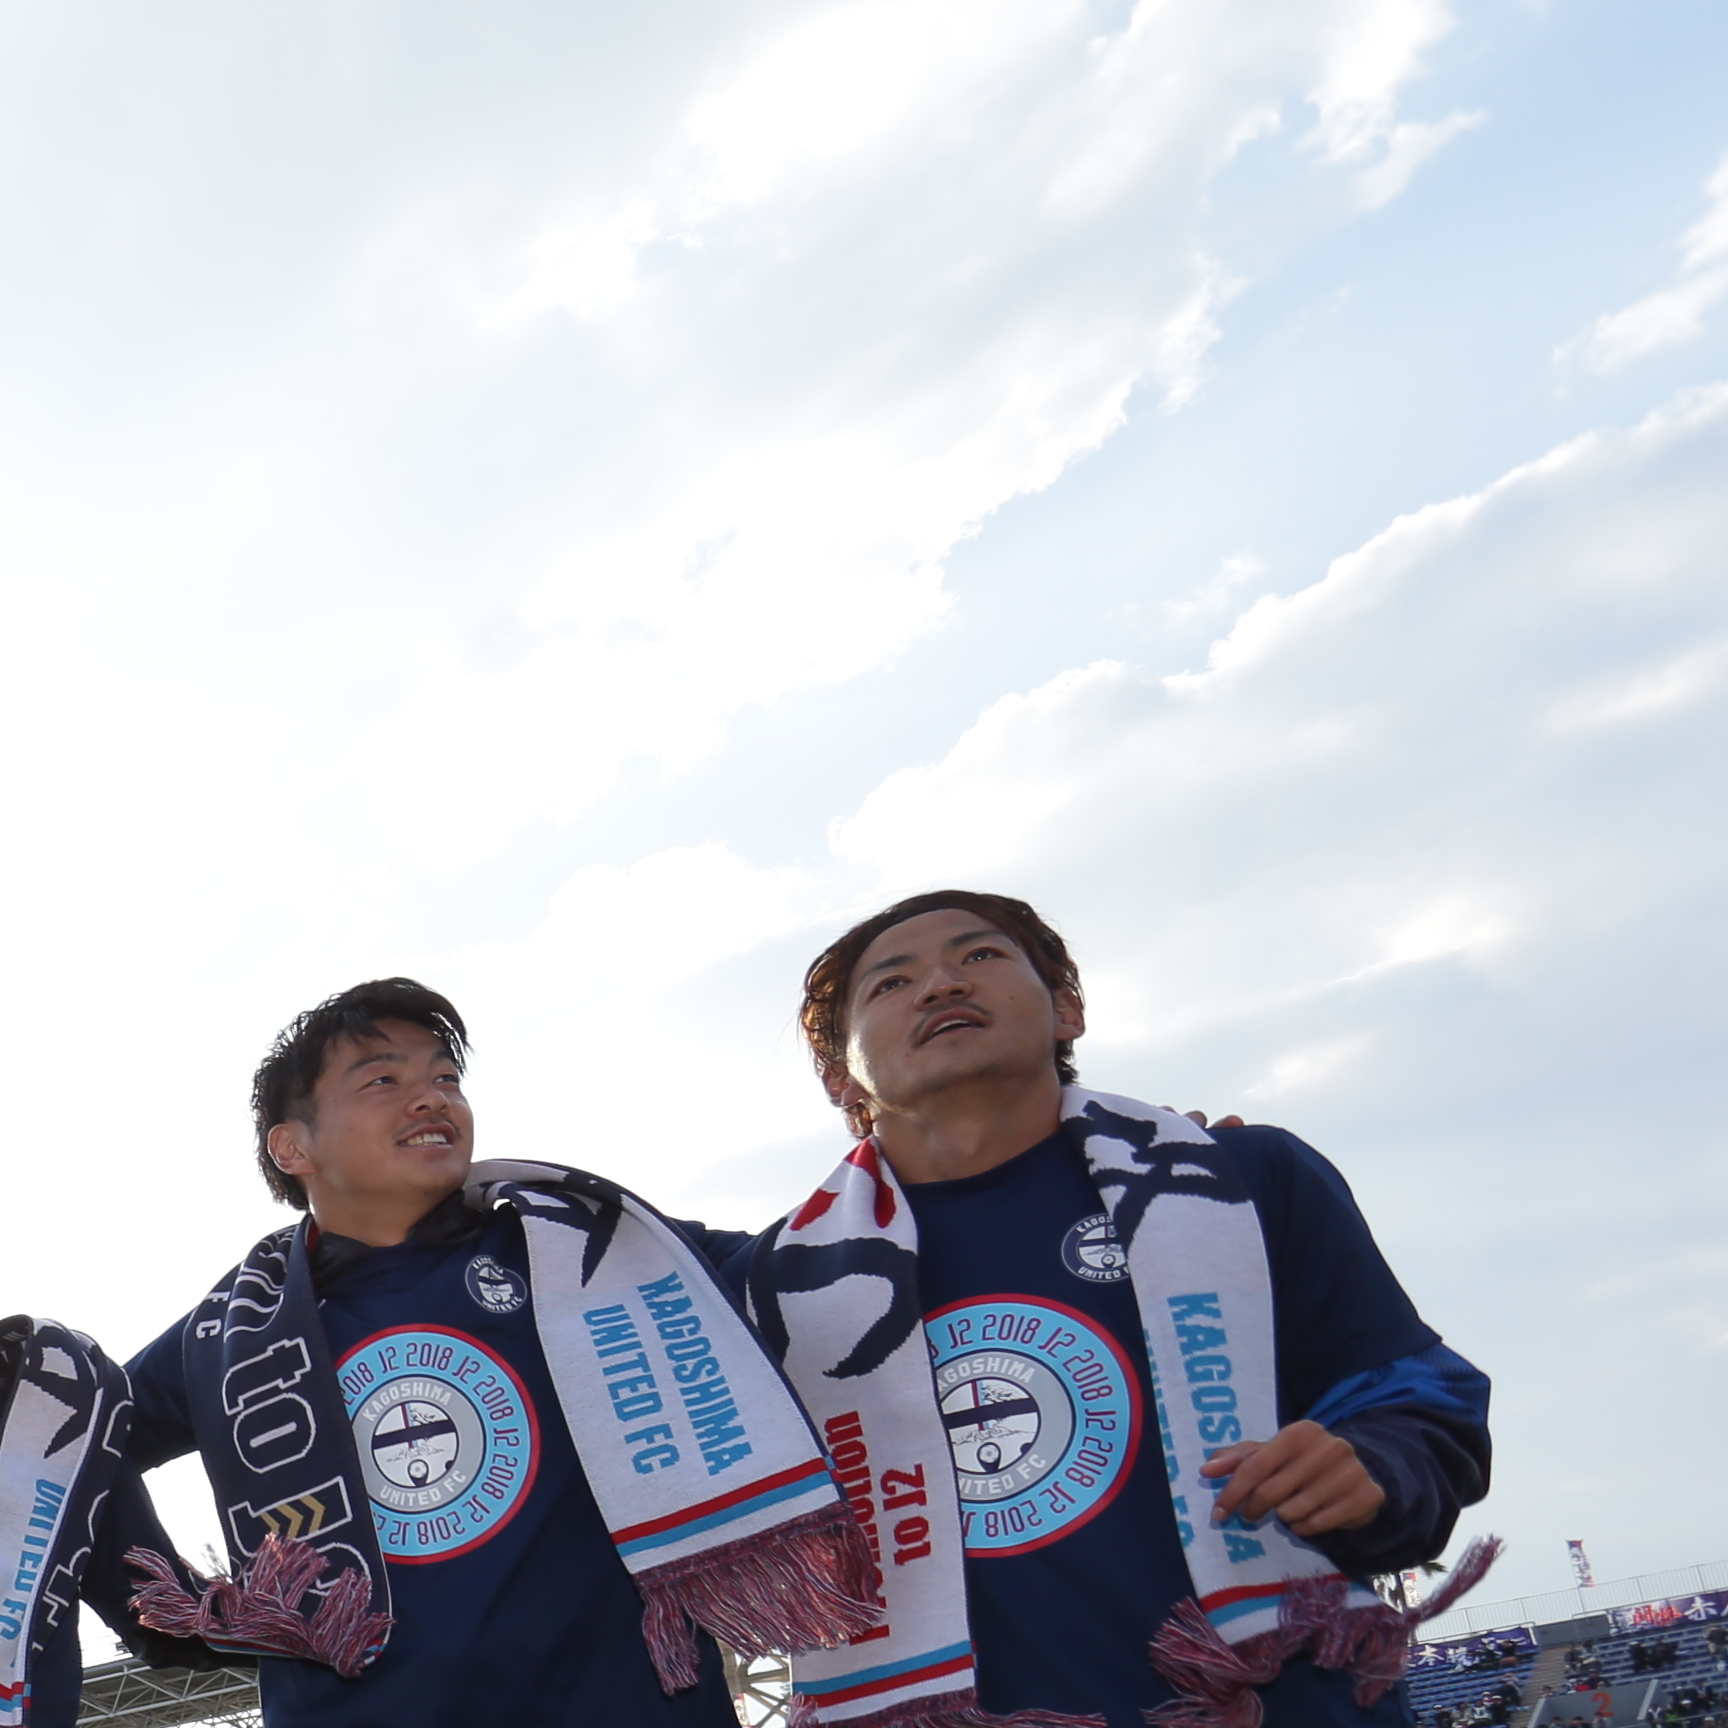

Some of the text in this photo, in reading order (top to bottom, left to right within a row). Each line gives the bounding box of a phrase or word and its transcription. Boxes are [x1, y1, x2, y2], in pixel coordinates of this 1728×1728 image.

[947, 1318, 974, 1350] J2
[981, 1314, 1042, 1344] 2018
[1037, 1326, 1077, 1359] J2
[377, 1346, 400, 1373] J2
[405, 1342, 454, 1371] 2018
[452, 1356, 481, 1385] J2
[583, 1304, 680, 1475] UNITED FC
[637, 1271, 753, 1477] KAGOSHIMA
[937, 1357, 1036, 1391] AGOSHIMA
[1062, 1349, 1113, 1402] 2018
[222, 1337, 317, 1475] to
[362, 1382, 453, 1422] KAGOSHIMA
[472, 1375, 515, 1422] 2018
[493, 1427, 520, 1447] J2
[1084, 1408, 1117, 1432] J2
[1167, 1292, 1267, 1564] KAGOSA
[481, 1453, 519, 1500] 2018
[1021, 1453, 1047, 1480] FC
[1064, 1436, 1114, 1488] 2018
[379, 1469, 467, 1506] UNITED FC
[1039, 1481, 1077, 1514] J2
[462, 1494, 491, 1523] J2
[880, 1463, 932, 1565] to J2
[984, 1499, 1043, 1538] 2018
[388, 1519, 410, 1546] J2
[417, 1511, 466, 1546] 2018
[1593, 1692, 1616, 1718] 2
